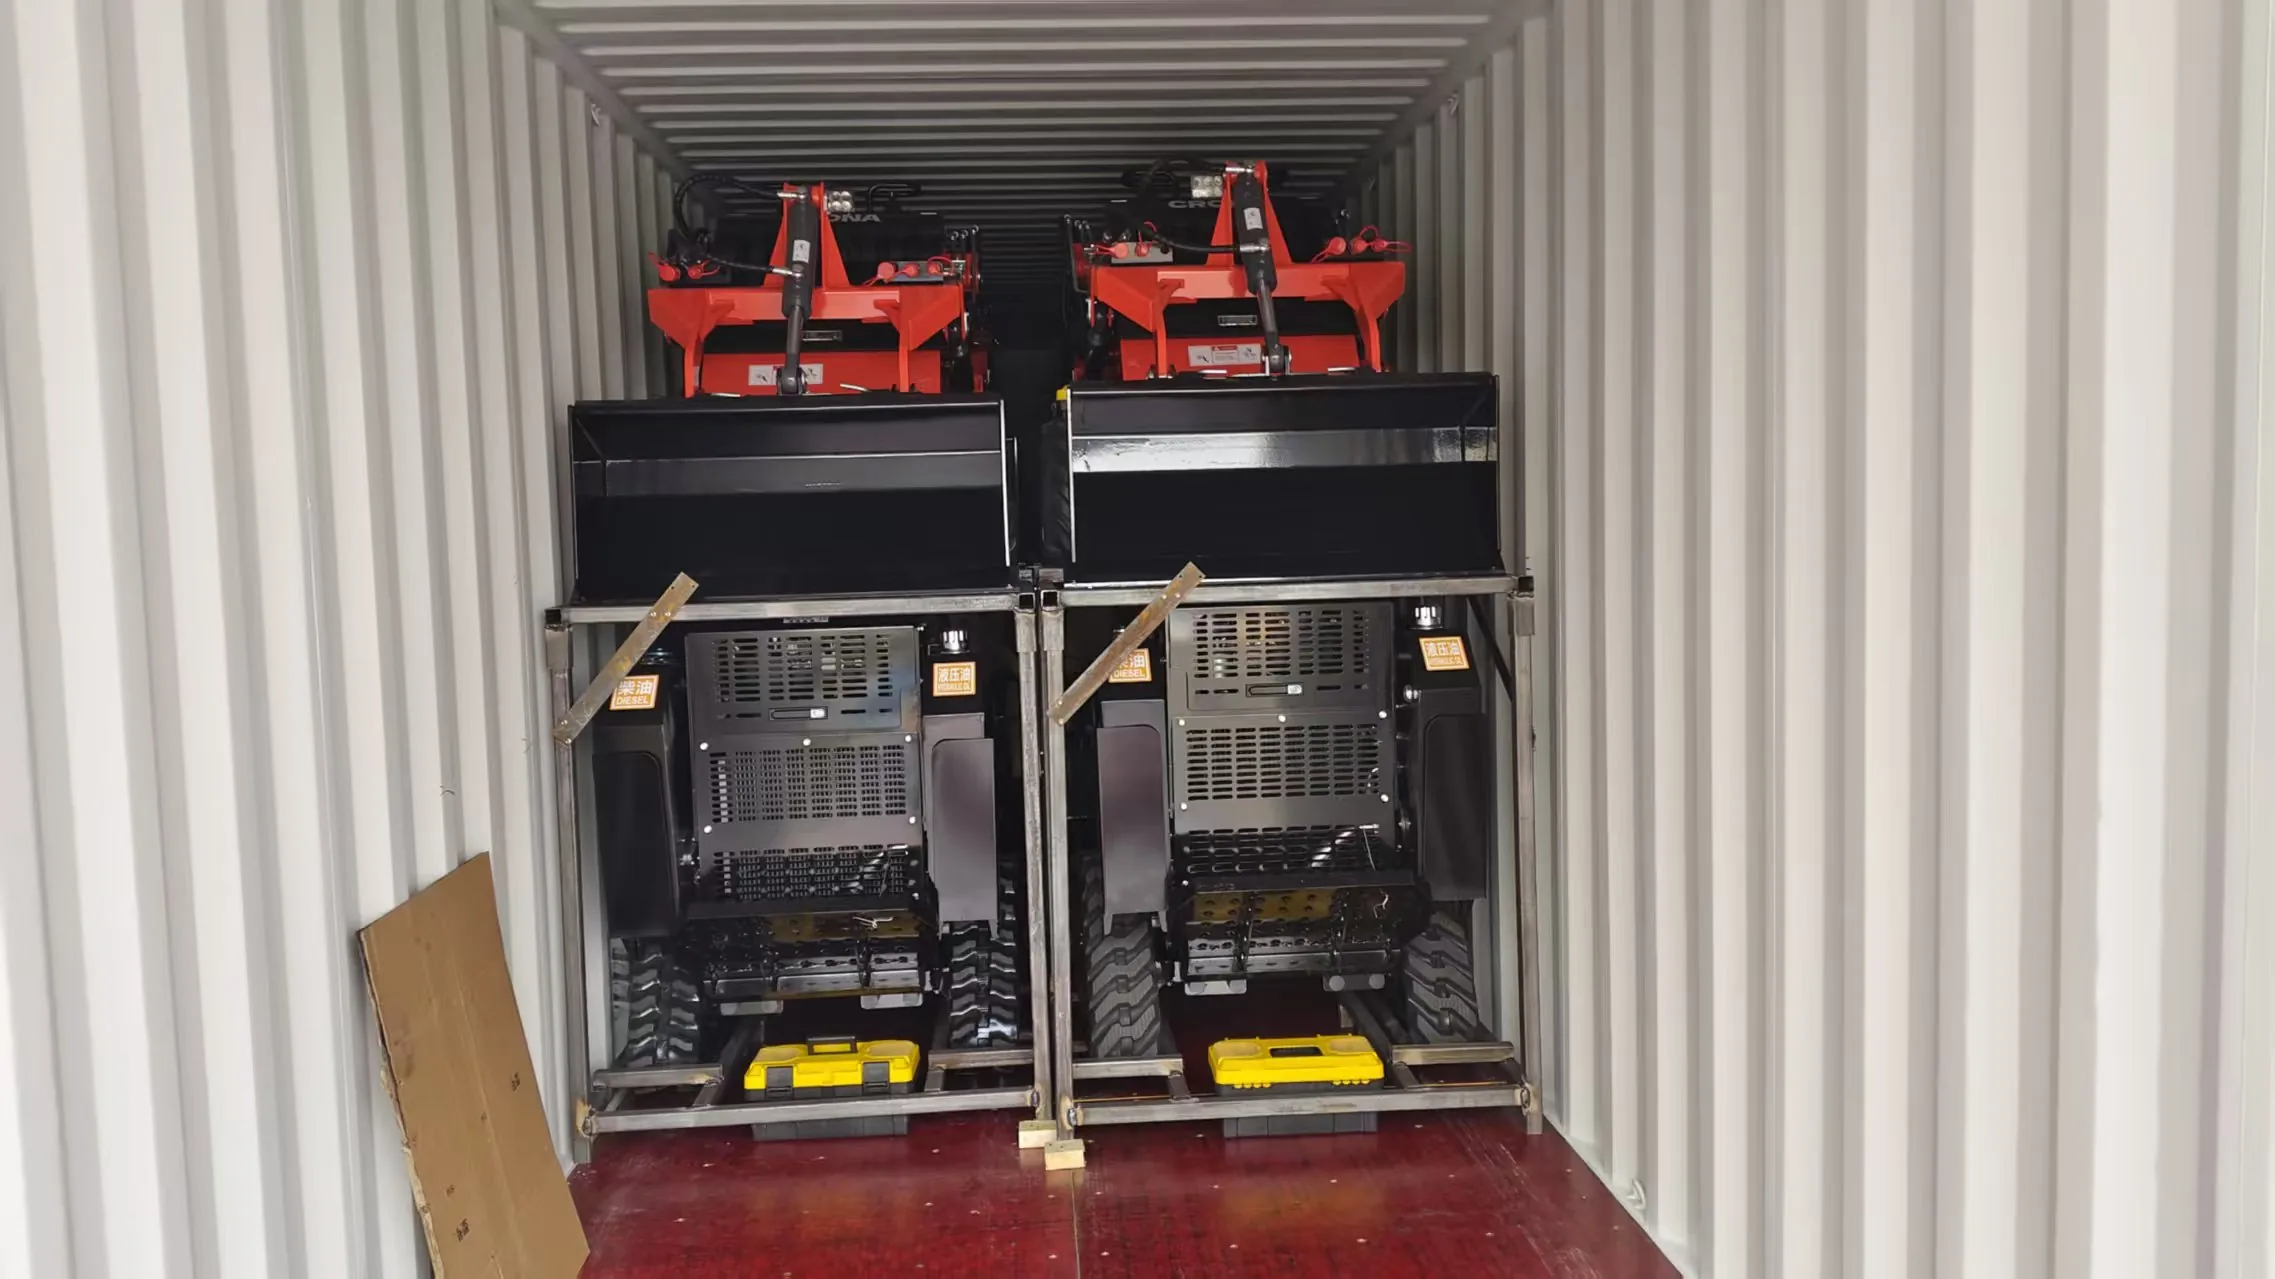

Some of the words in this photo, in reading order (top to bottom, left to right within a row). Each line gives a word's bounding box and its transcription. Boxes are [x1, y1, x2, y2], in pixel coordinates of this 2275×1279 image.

[1113, 668, 1146, 678] DIESEL
[617, 680, 653, 696] 柴油
[615, 695, 650, 705] DIESEL
